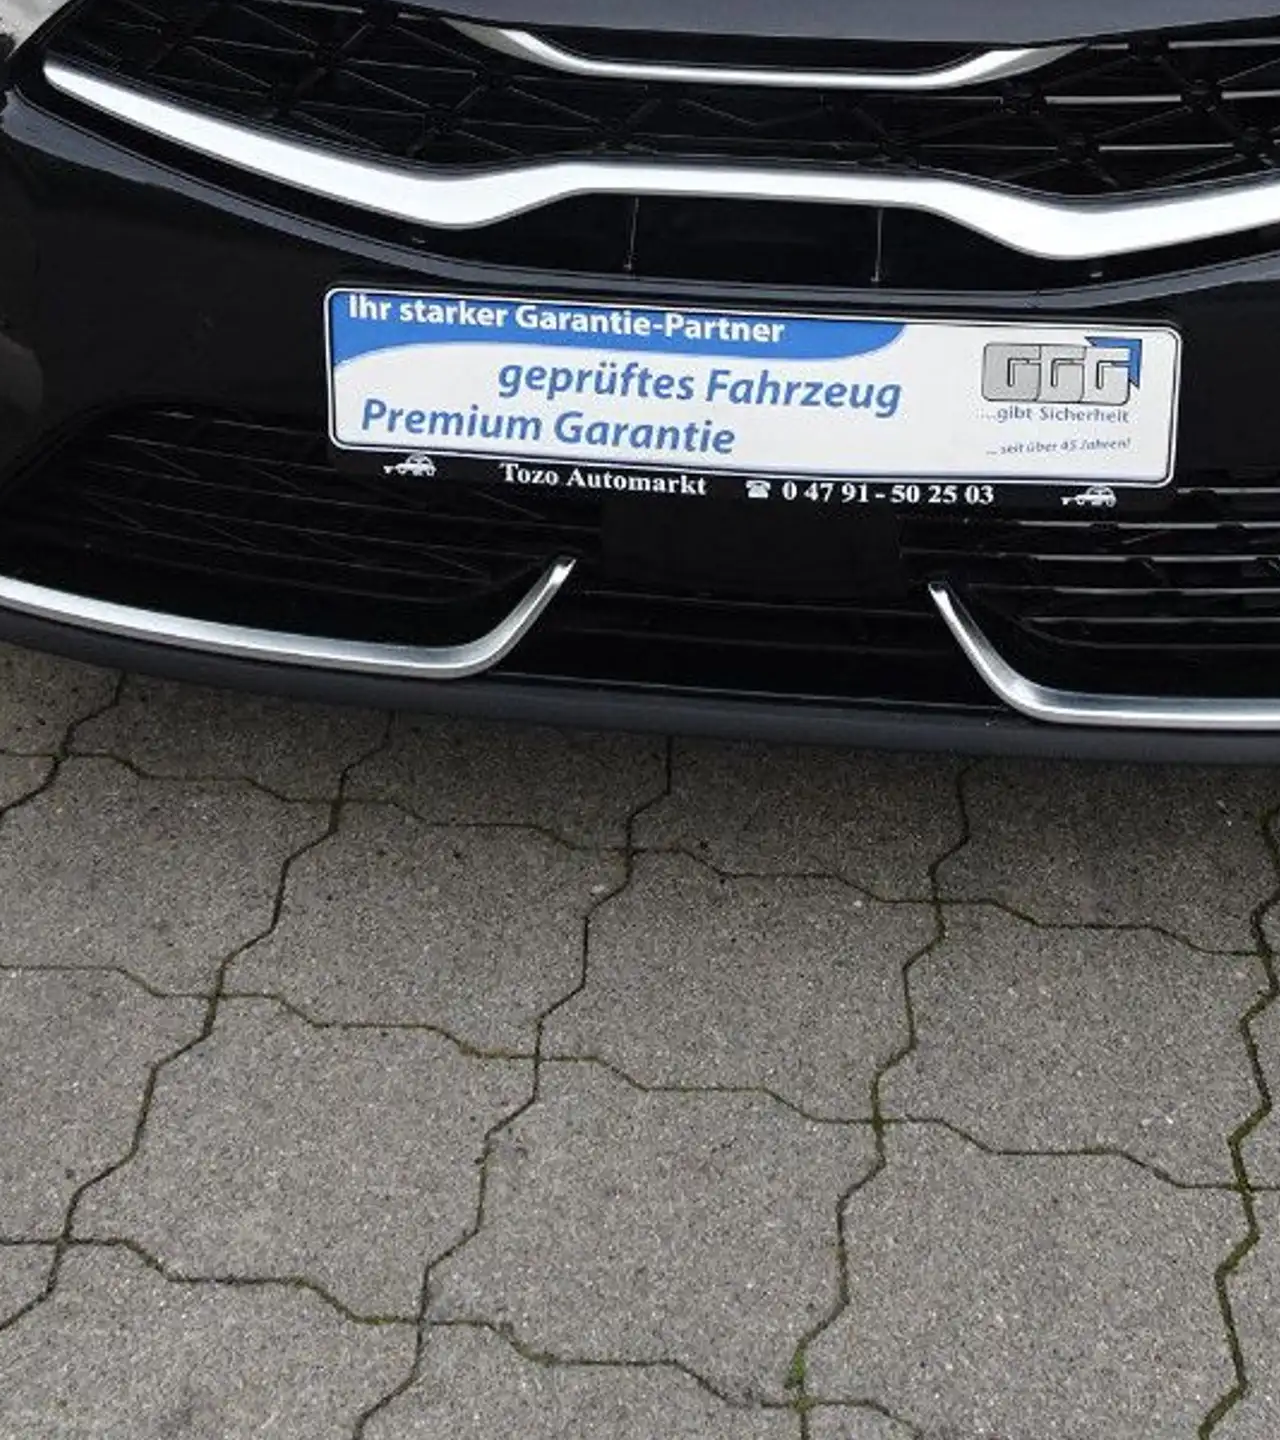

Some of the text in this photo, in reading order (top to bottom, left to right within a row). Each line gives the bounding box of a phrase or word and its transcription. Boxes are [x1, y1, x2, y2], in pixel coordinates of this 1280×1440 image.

[348, 294, 785, 343] Ihr starker Garantie-Partner
[498, 361, 902, 419] geprüftes Fahrzeug
[361, 398, 736, 454] Premium Garantie
[1039, 406, 1130, 424] Sicherheit
[1026, 439, 1058, 453] über
[499, 463, 708, 495] Tozo Automarkt
[782, 483, 798, 501] 0
[803, 483, 835, 502] 47
[928, 485, 958, 504] 25
[964, 485, 995, 504] 03
